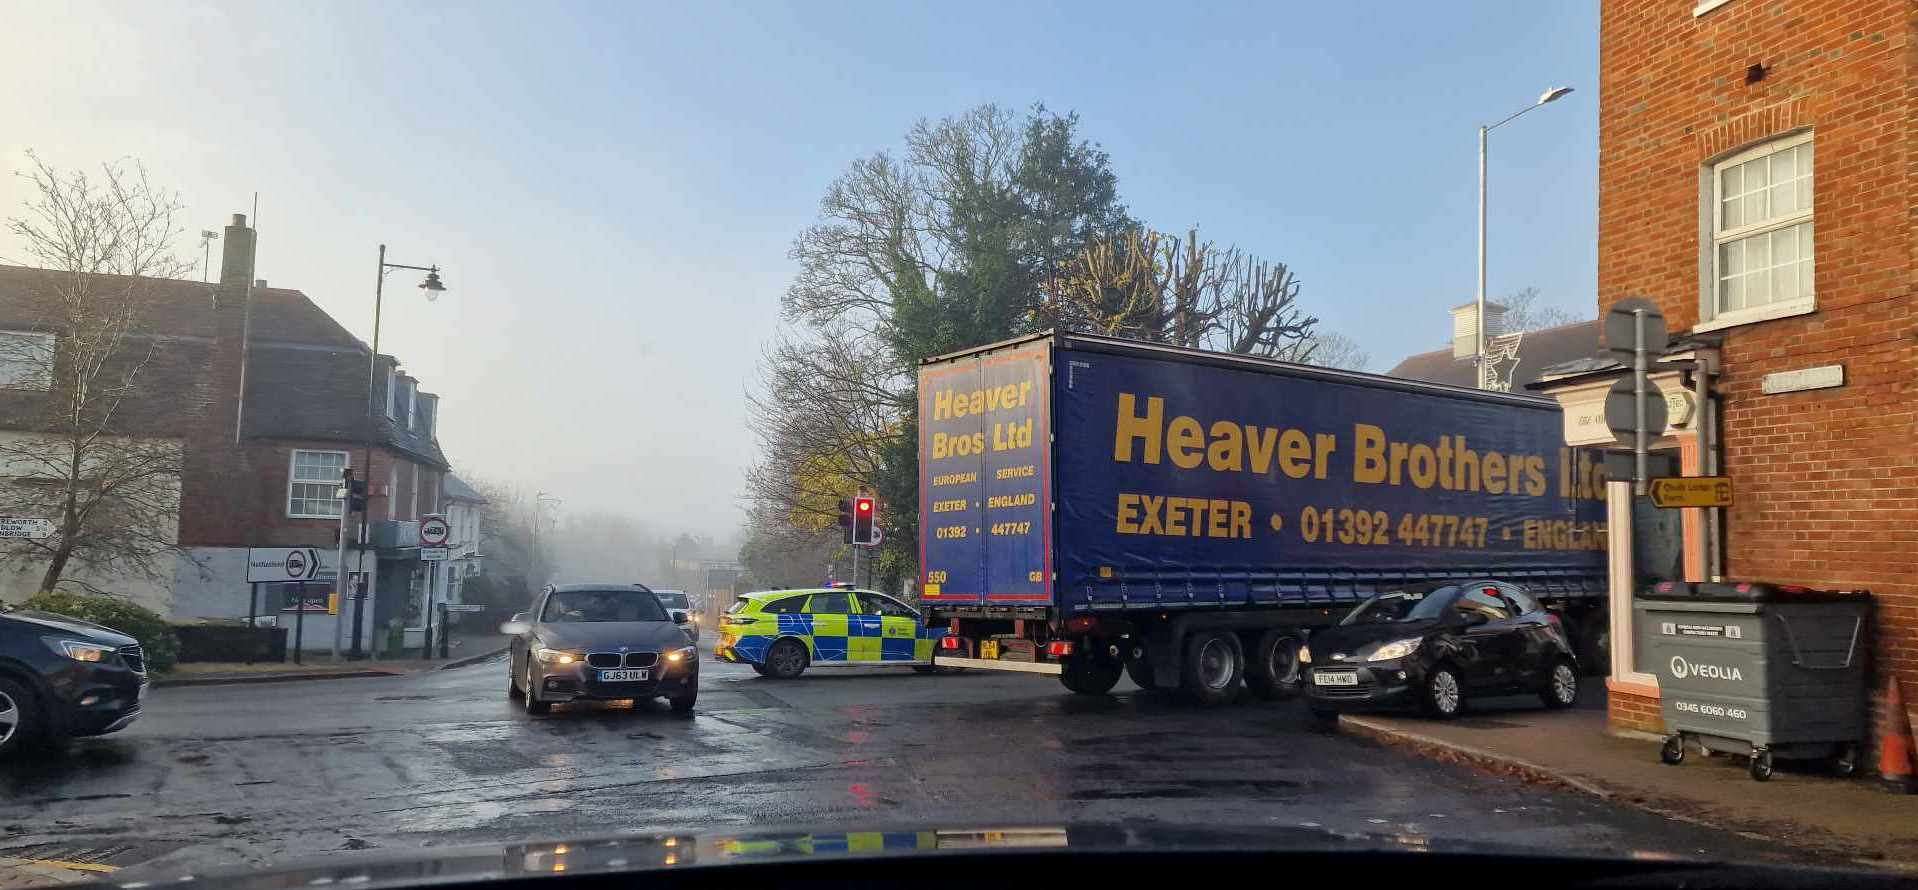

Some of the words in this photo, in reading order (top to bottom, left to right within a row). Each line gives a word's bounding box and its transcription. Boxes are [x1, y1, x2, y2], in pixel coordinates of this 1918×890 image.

[934, 380, 1032, 420] Heaver
[932, 432, 985, 459] Bros
[992, 418, 1033, 452] Ltd
[1114, 392, 1337, 481] Heaver
[1353, 422, 1547, 497] Brothers
[933, 471, 977, 486] EUROPEAN
[996, 465, 1034, 481] SERVICE
[934, 499, 968, 512] EXETER
[988, 493, 1036, 509] ENGLAND
[936, 526, 968, 539] 01392
[991, 522, 1031, 537] 447747
[1117, 493, 1252, 540] EXETER
[1301, 506, 1390, 546] 01392
[1398, 513, 1490, 549] 447747
[1523, 519, 1608, 551] ENGLAN
[927, 571, 947, 584] 550
[1029, 570, 1043, 582] GB
[604, 671, 627, 680] GJ63
[1688, 663, 1743, 681] VEOLIA
[1675, 701, 1699, 713] 0345
[1700, 704, 1725, 717] 6060
